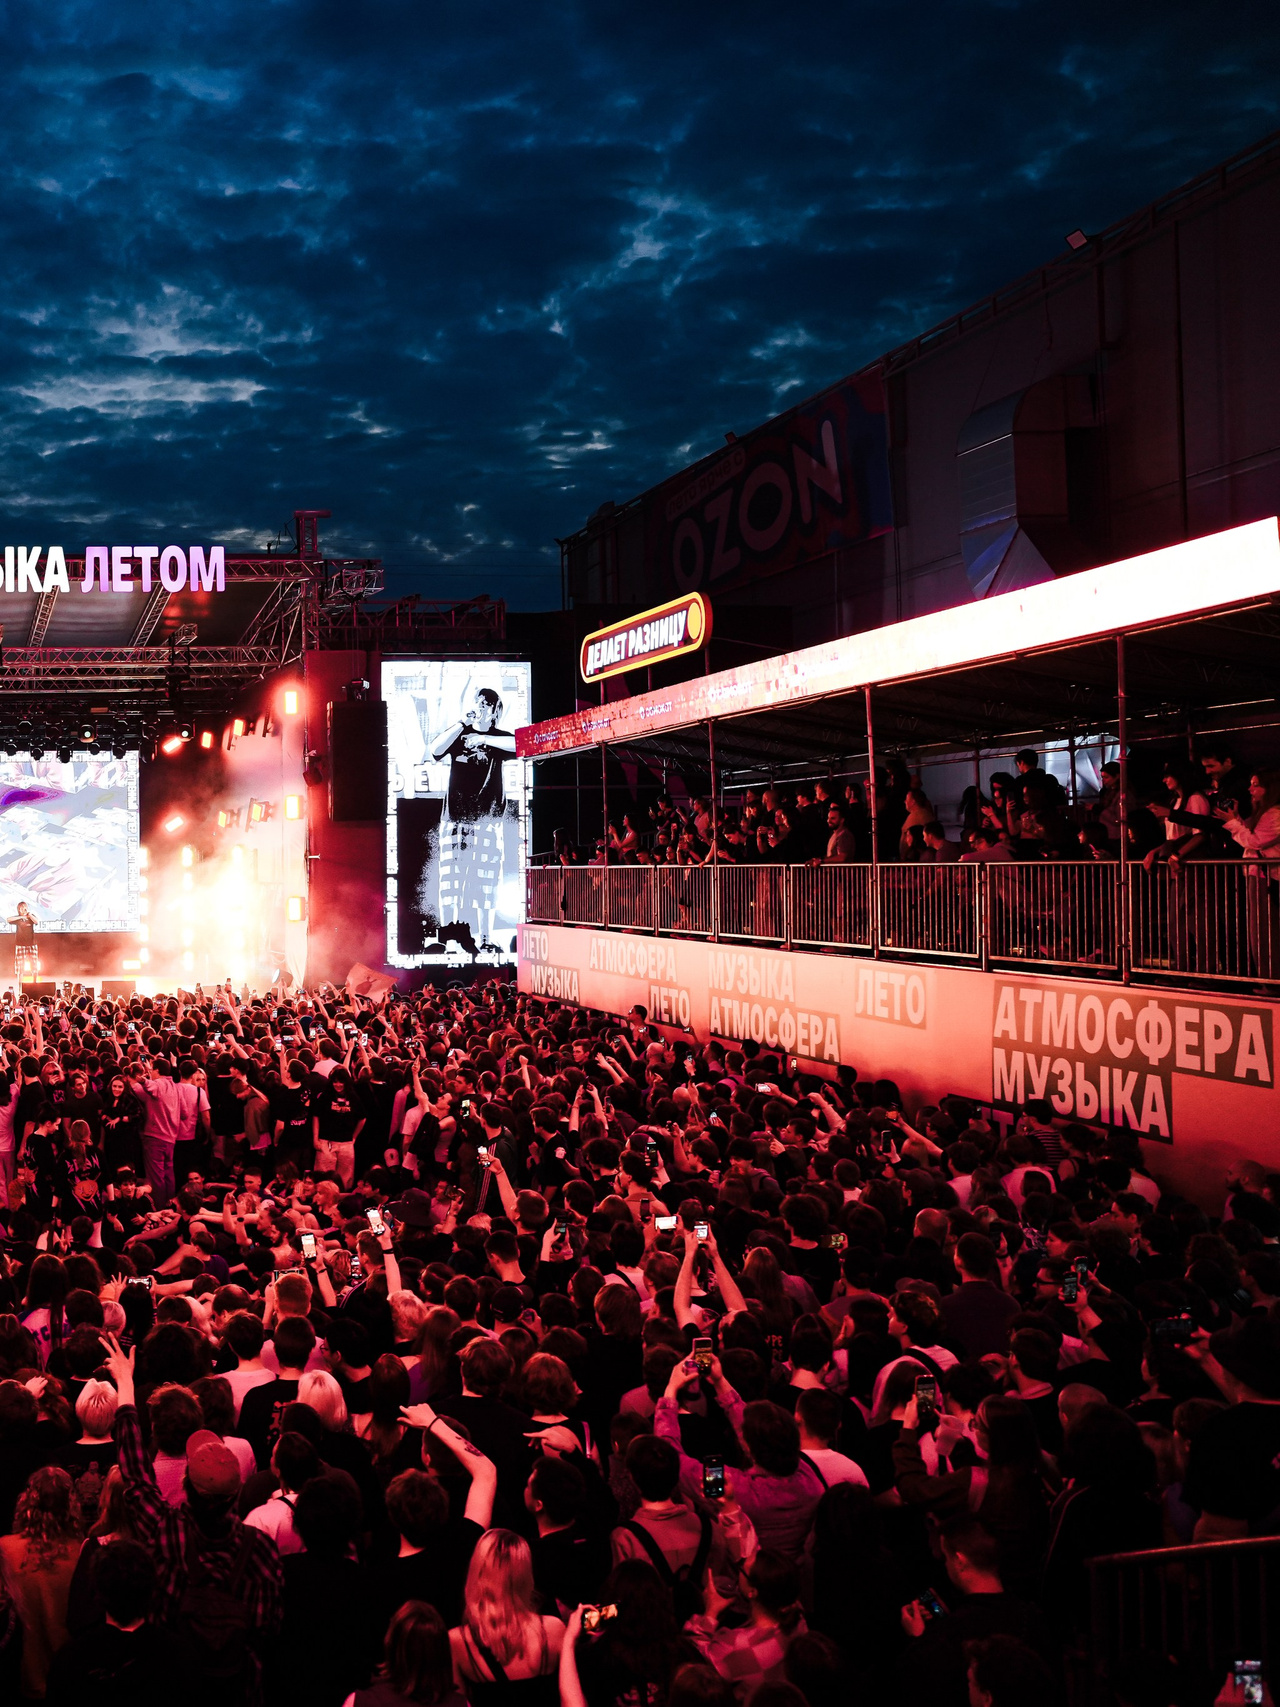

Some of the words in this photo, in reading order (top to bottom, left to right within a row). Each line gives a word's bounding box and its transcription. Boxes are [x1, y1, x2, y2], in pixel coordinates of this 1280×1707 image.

[673, 419, 844, 593] OZON
[81, 545, 226, 593] ЛЕТОМ
[586, 631, 628, 676] ДЕЛАЕТ
[628, 609, 688, 657] РАЗНИЦУ
[522, 929, 549, 961] ЛЕТО
[589, 937, 678, 982] АТМОСФЕРА
[531, 963, 580, 1002] МУЗЫКА
[707, 951, 795, 1003] МУЗЫКА
[855, 968, 926, 1025] ЛЕТО
[649, 984, 691, 1027] ЛЕТО
[710, 996, 840, 1063] АТМОСФЕРА
[993, 986, 1272, 1082] АТМОСФЕРА
[993, 1047, 1170, 1137] МУЗЫКА
